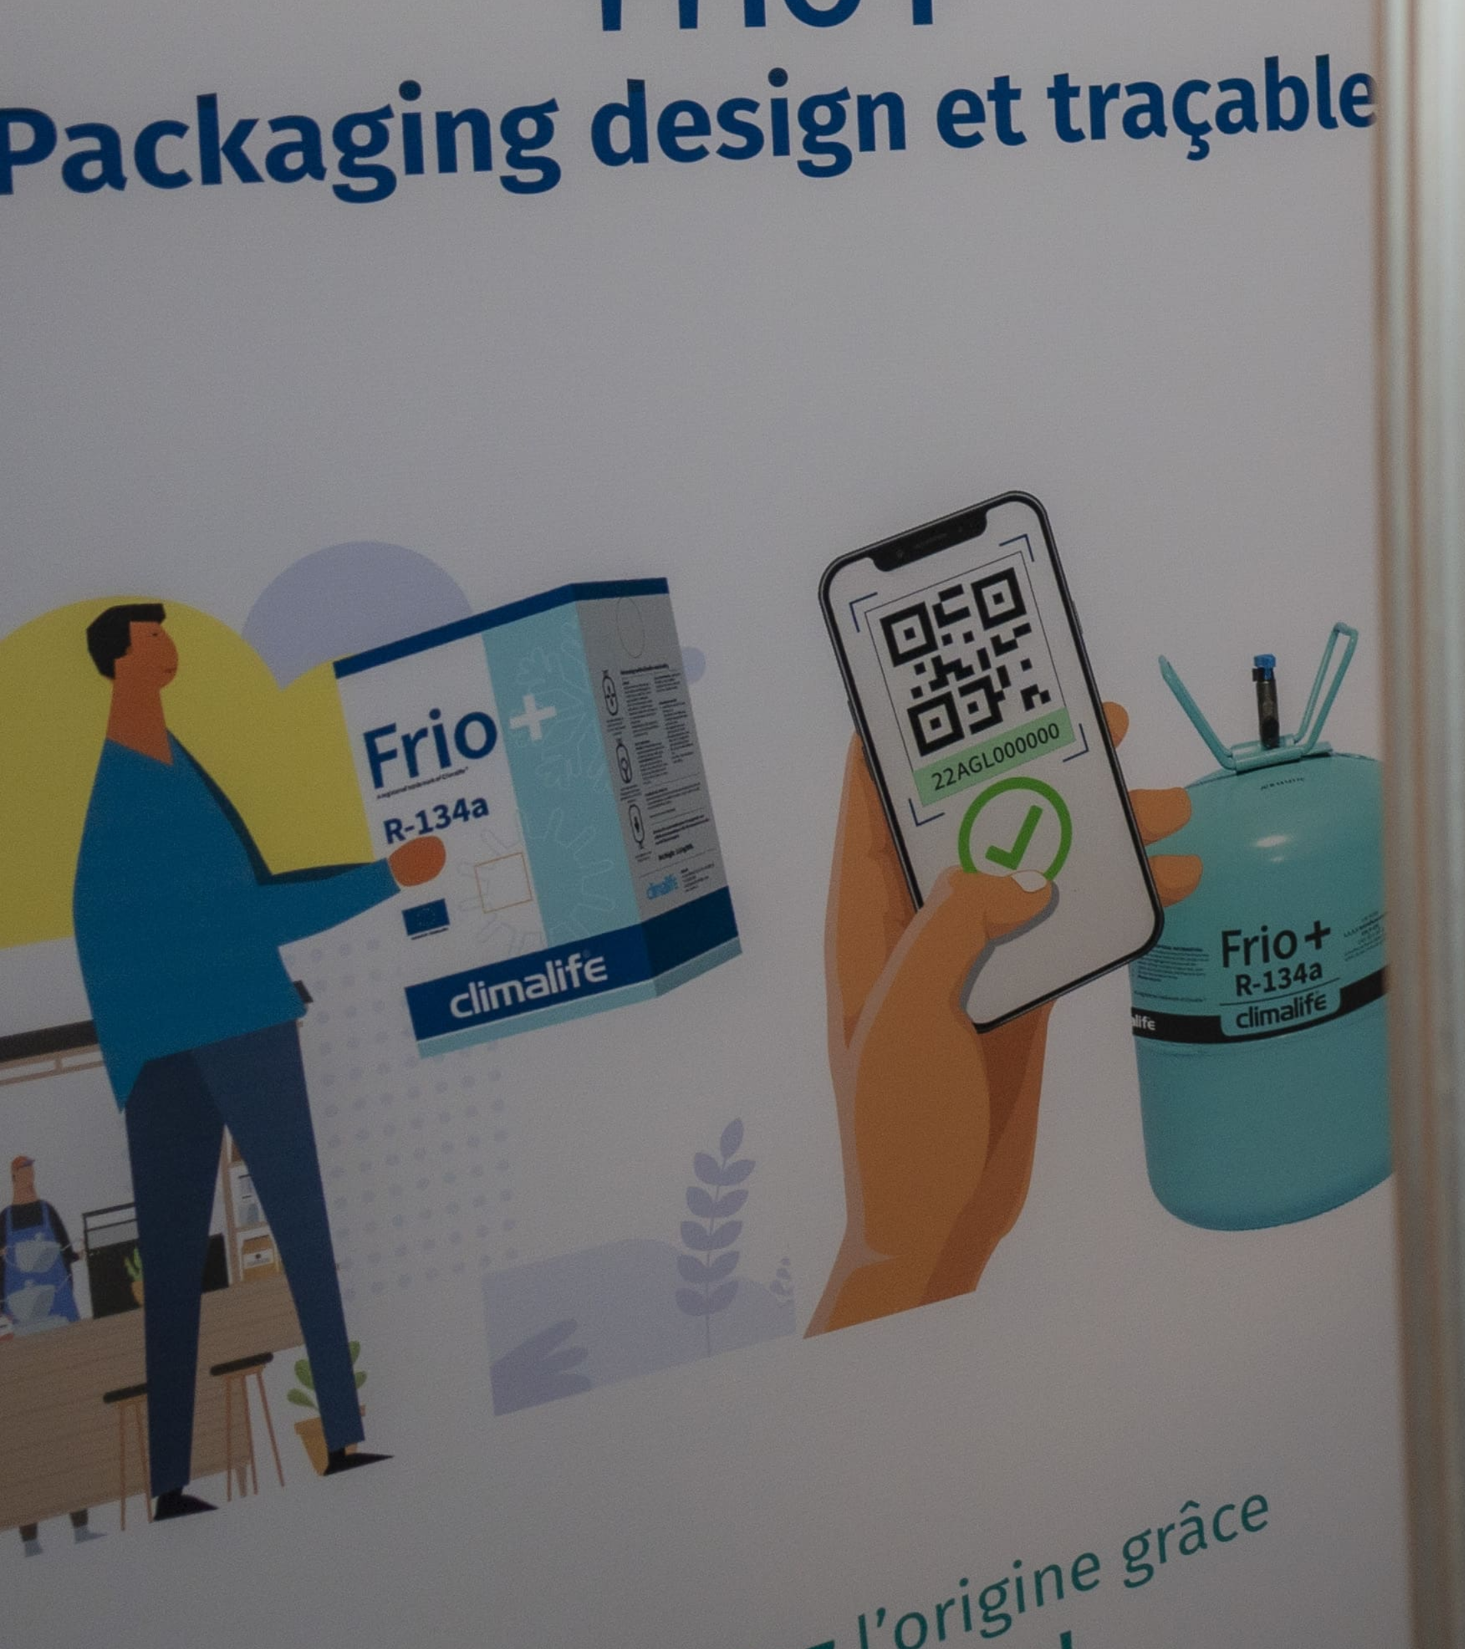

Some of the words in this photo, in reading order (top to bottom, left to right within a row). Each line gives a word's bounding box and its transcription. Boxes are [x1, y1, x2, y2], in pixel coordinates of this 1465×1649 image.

[0, 77, 562, 205] Packaging
[589, 66, 908, 179] design
[936, 73, 1026, 148] et
[1045, 52, 1379, 160] traçable
[931, 721, 1062, 792] 22AGL000000
[383, 795, 490, 846] R-134a
[449, 953, 608, 1020] climalife
[1235, 961, 1323, 997] R-134a
[1236, 993, 1327, 1029] climalife
[1121, 1492, 1270, 1589] grâce
